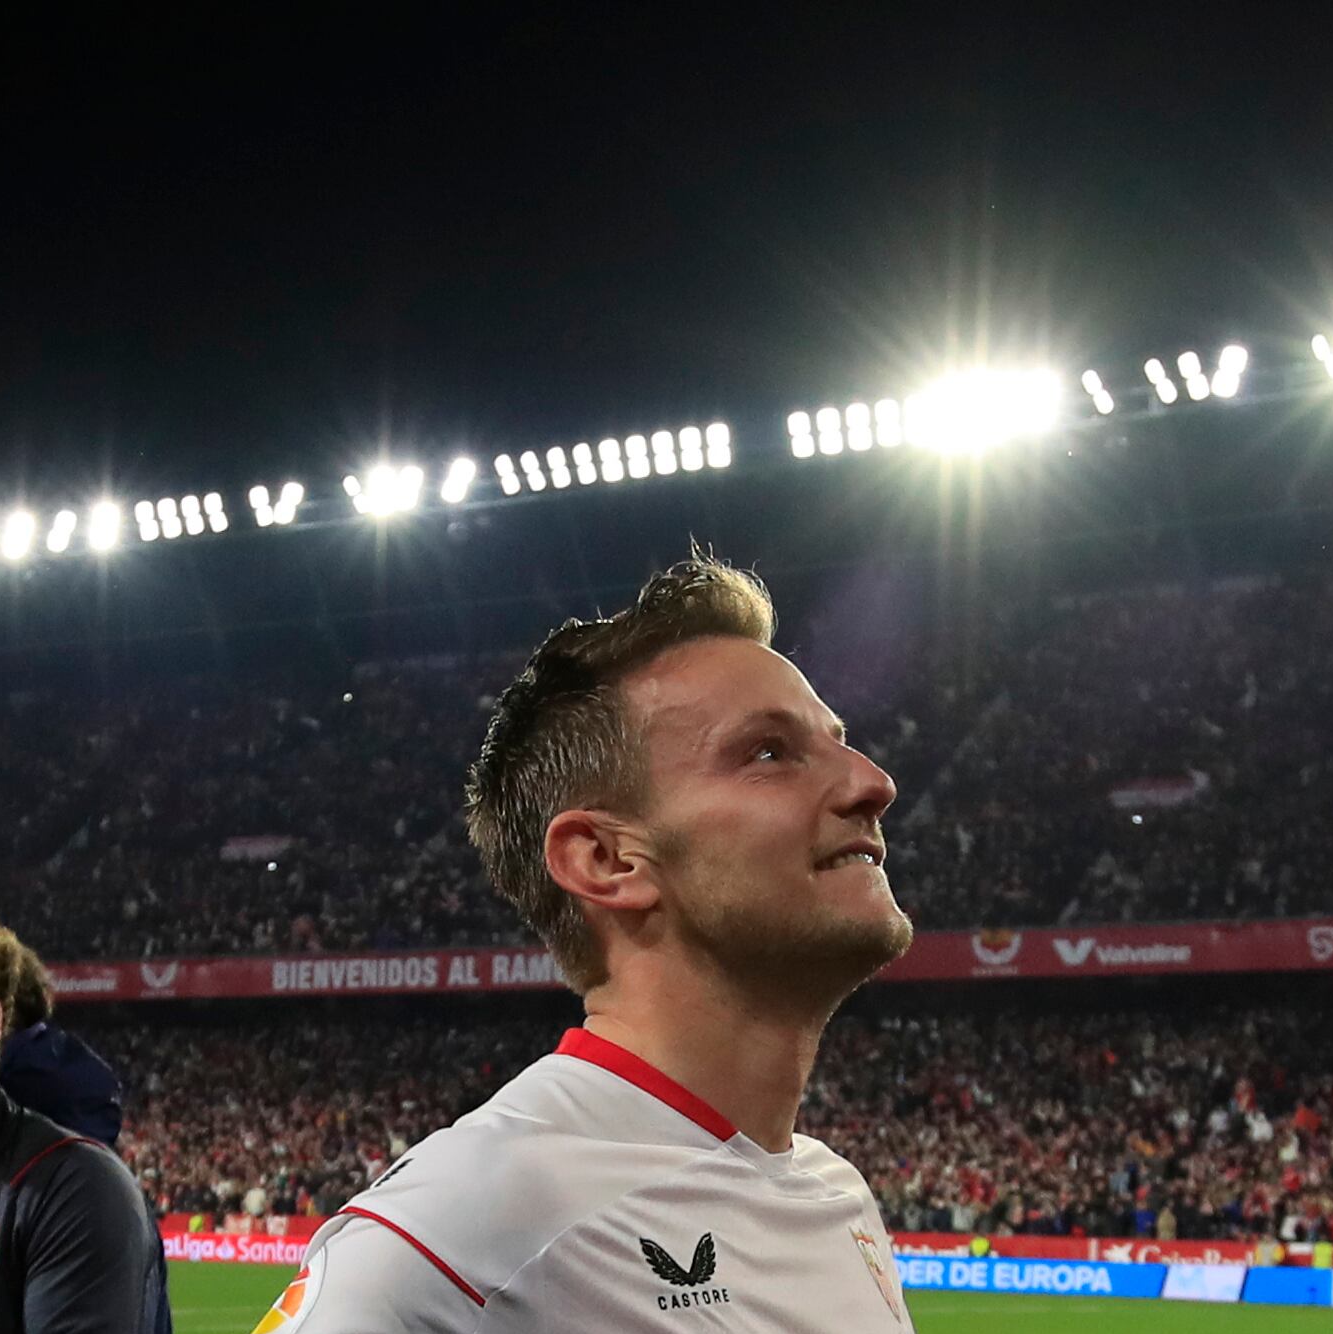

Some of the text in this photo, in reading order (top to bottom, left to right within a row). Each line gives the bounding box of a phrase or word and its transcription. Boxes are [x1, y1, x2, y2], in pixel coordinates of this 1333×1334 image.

[272, 957, 439, 990] BIENVENIDOS
[448, 955, 480, 986] AL
[163, 1234, 215, 1260] aLiga
[949, 1261, 988, 1287] DE
[993, 1262, 1112, 1293] EUROPA
[657, 1288, 730, 1311] CASTORE
